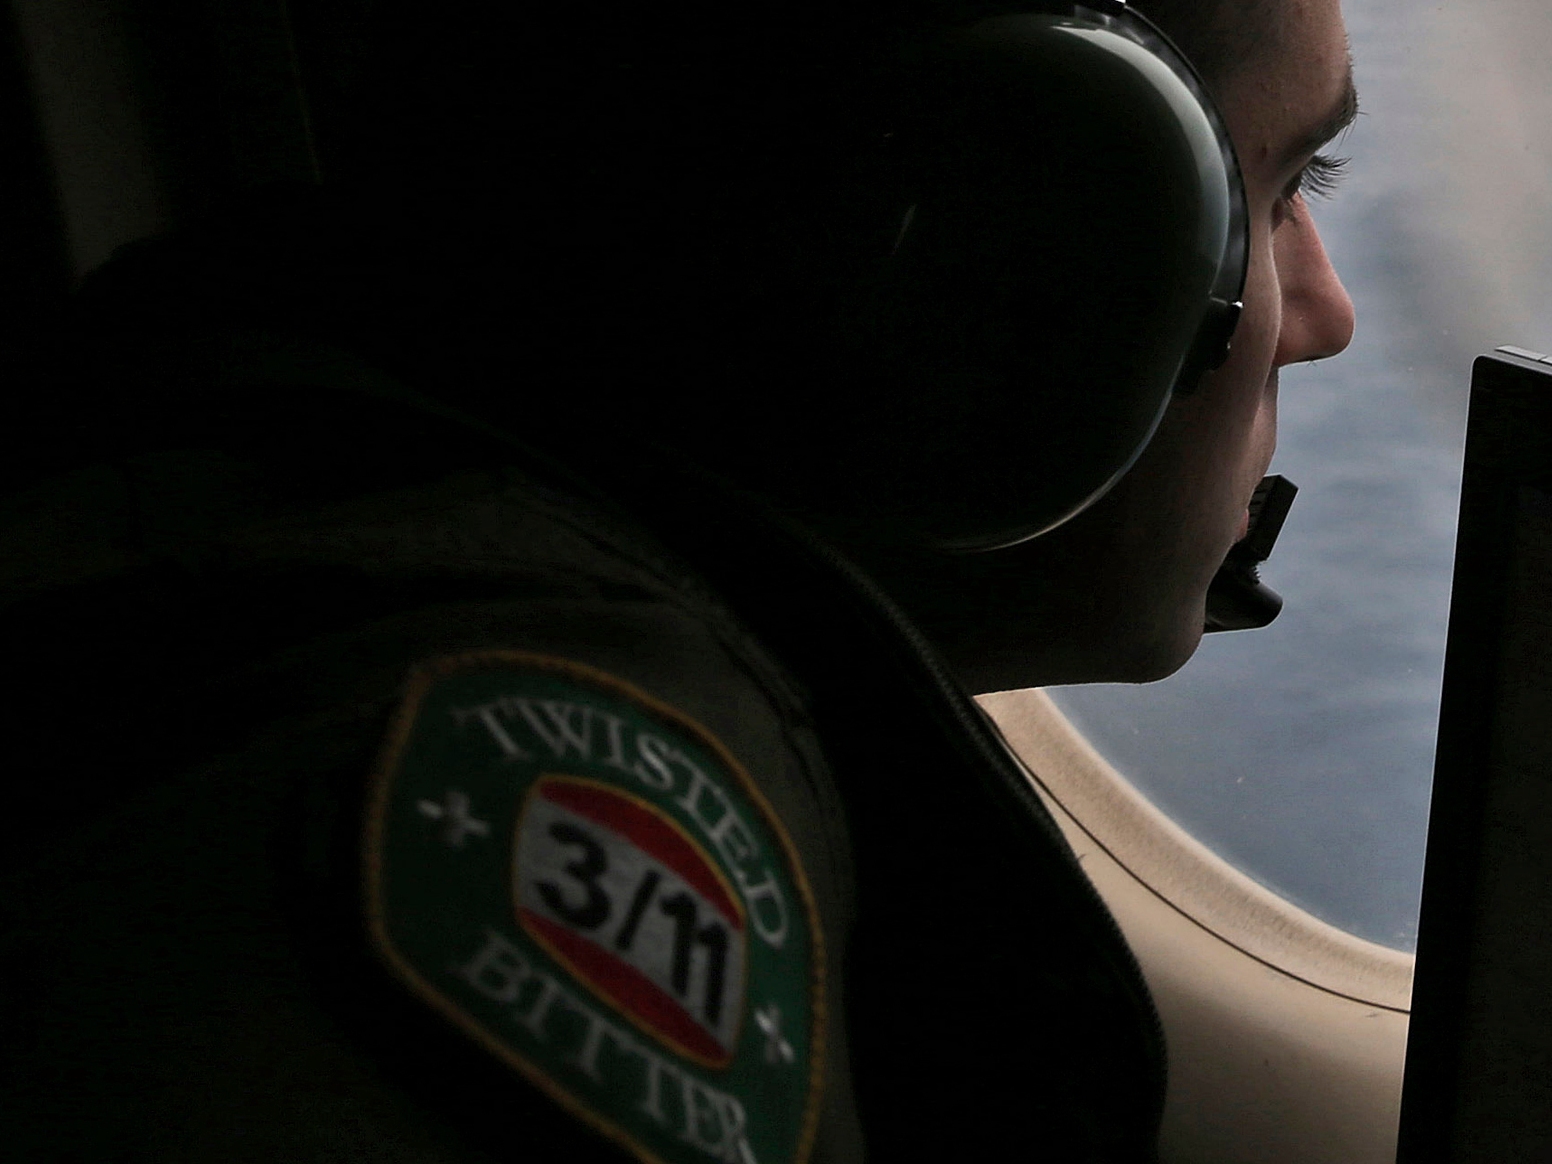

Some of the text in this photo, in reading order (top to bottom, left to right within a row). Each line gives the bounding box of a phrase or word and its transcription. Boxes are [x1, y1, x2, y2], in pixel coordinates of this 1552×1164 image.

[451, 697, 788, 949] TWISTED
[534, 821, 732, 1026] 3/11
[455, 931, 759, 1164] BITTER
